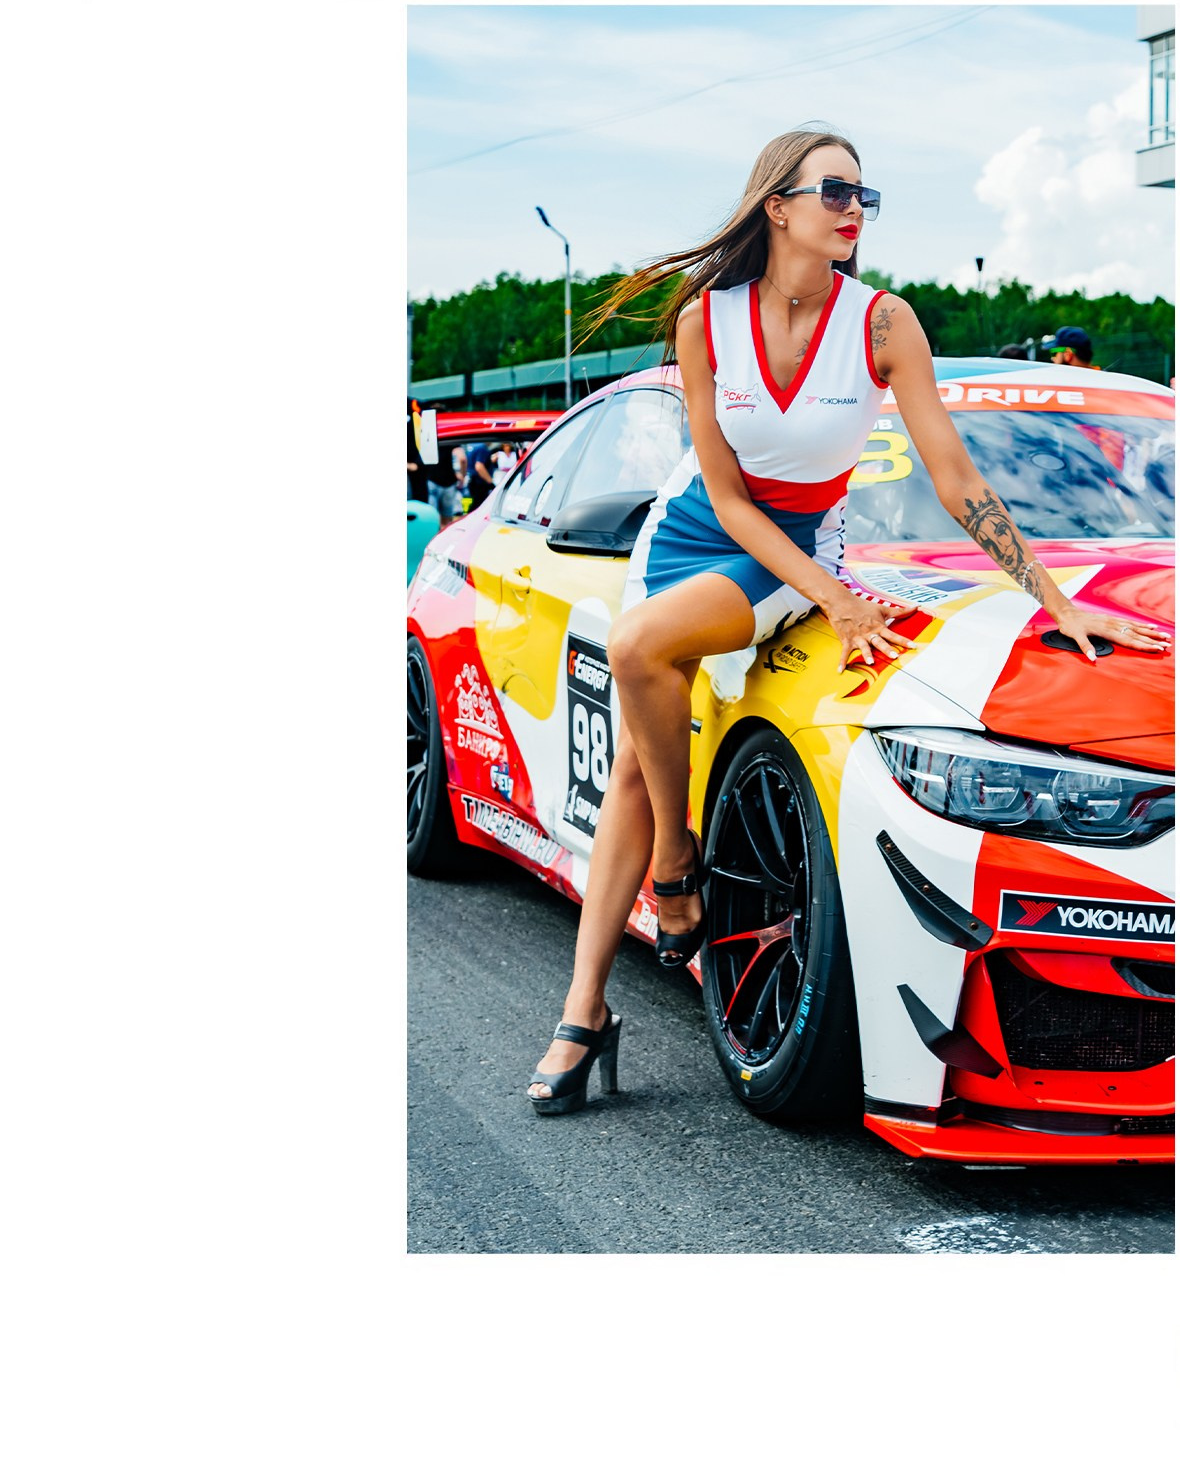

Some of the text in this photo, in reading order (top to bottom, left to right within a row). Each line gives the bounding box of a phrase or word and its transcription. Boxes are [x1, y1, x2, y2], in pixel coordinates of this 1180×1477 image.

[723, 390, 752, 402] РСКГ
[819, 396, 858, 405] YOKOHAMA
[936, 383, 1086, 406] DRIVE
[572, 703, 609, 793] 98
